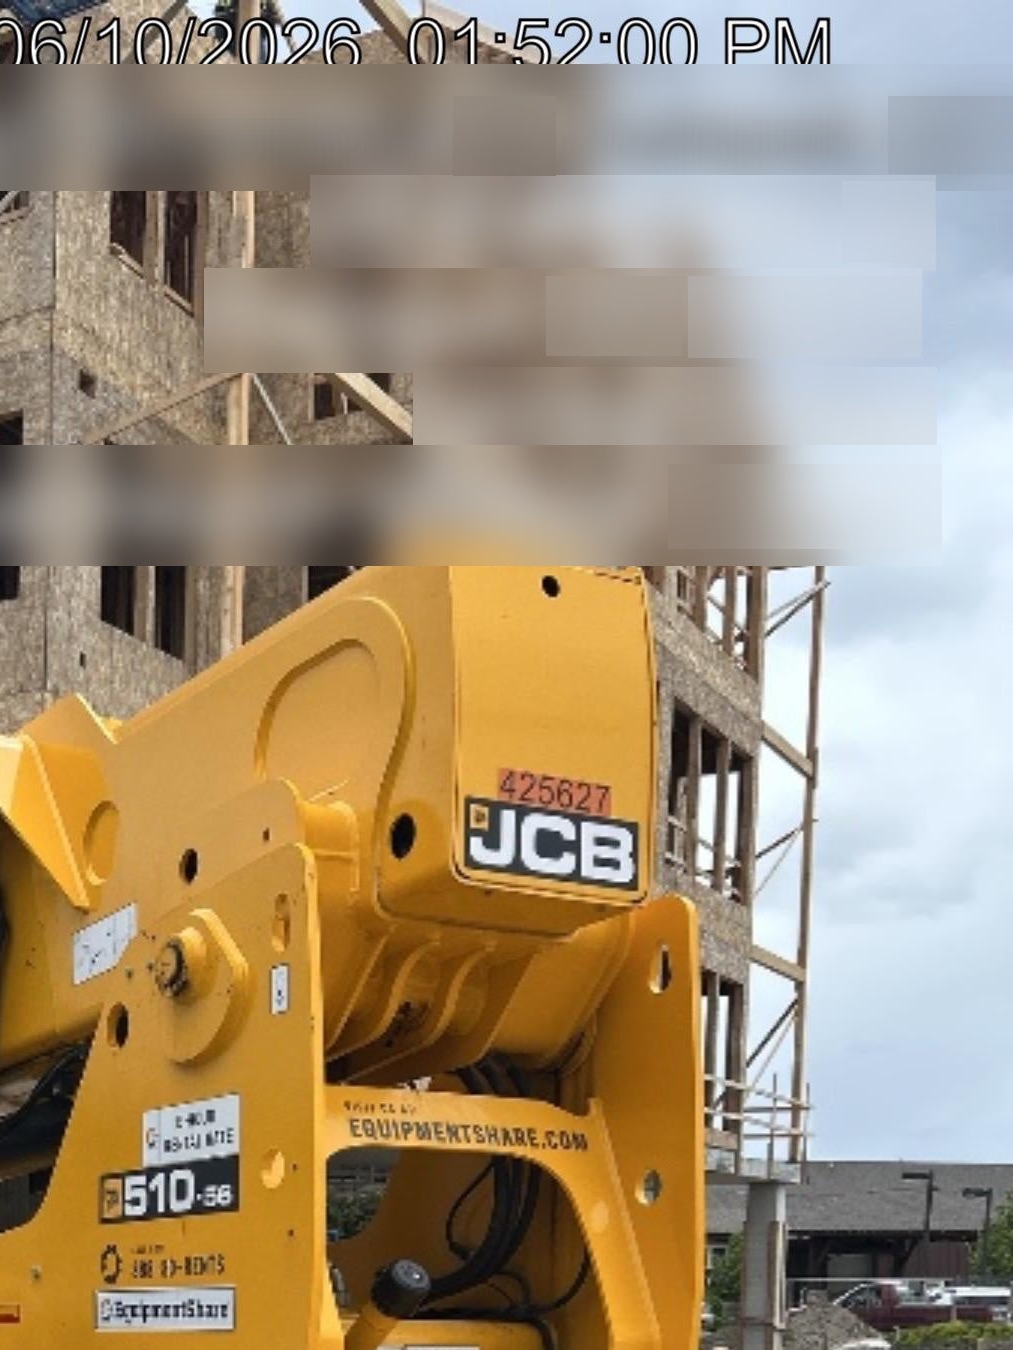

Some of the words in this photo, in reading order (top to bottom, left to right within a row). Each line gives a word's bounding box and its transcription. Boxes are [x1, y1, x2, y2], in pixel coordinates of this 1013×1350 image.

[500, 770, 611, 814] 425627
[469, 809, 637, 884] JCB
[349, 1117, 588, 1151] EQUIPMENTSHARE.COM
[114, 1298, 230, 1325] EquipmentShare
